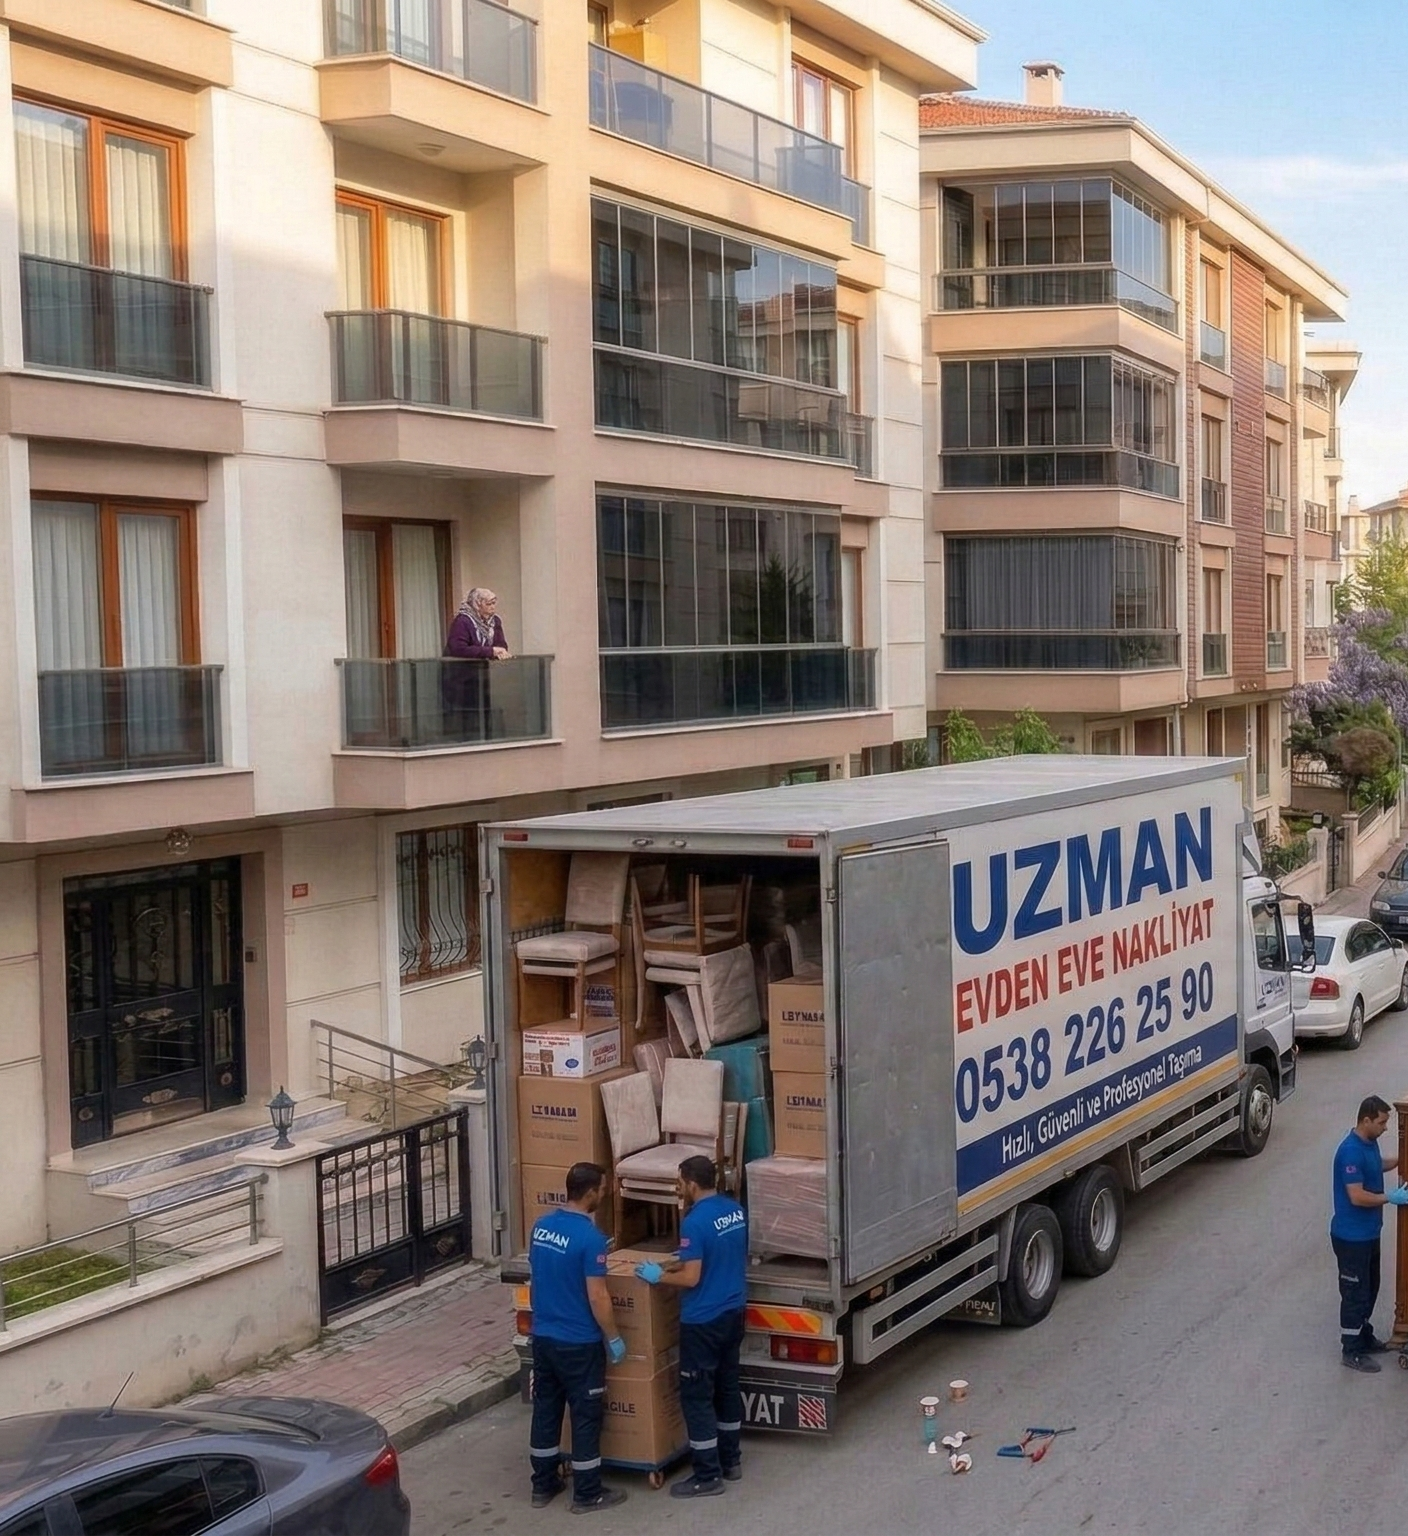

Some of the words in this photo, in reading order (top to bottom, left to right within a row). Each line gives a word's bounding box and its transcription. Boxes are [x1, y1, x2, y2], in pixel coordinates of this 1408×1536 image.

[953, 806, 1213, 955] UZMAN
[956, 954, 1048, 1034] EVDEN
[1058, 935, 1104, 994] EVE
[1113, 898, 1214, 975] NAKLİYAT
[956, 1027, 1051, 1124] 0538
[1064, 997, 1126, 1077] 226
[1136, 976, 1172, 1043] 25
[1181, 961, 1213, 1021] 90
[1002, 1124, 1034, 1163] Hızlı,
[1038, 1098, 1084, 1143] Güvenli
[1087, 1098, 1101, 1118] ve
[1103, 1057, 1166, 1111] Profesyonel
[1168, 1045, 1202, 1079] Taşıma
[533, 1227, 570, 1248] UZMAN
[740, 1391, 784, 1424] YAT
